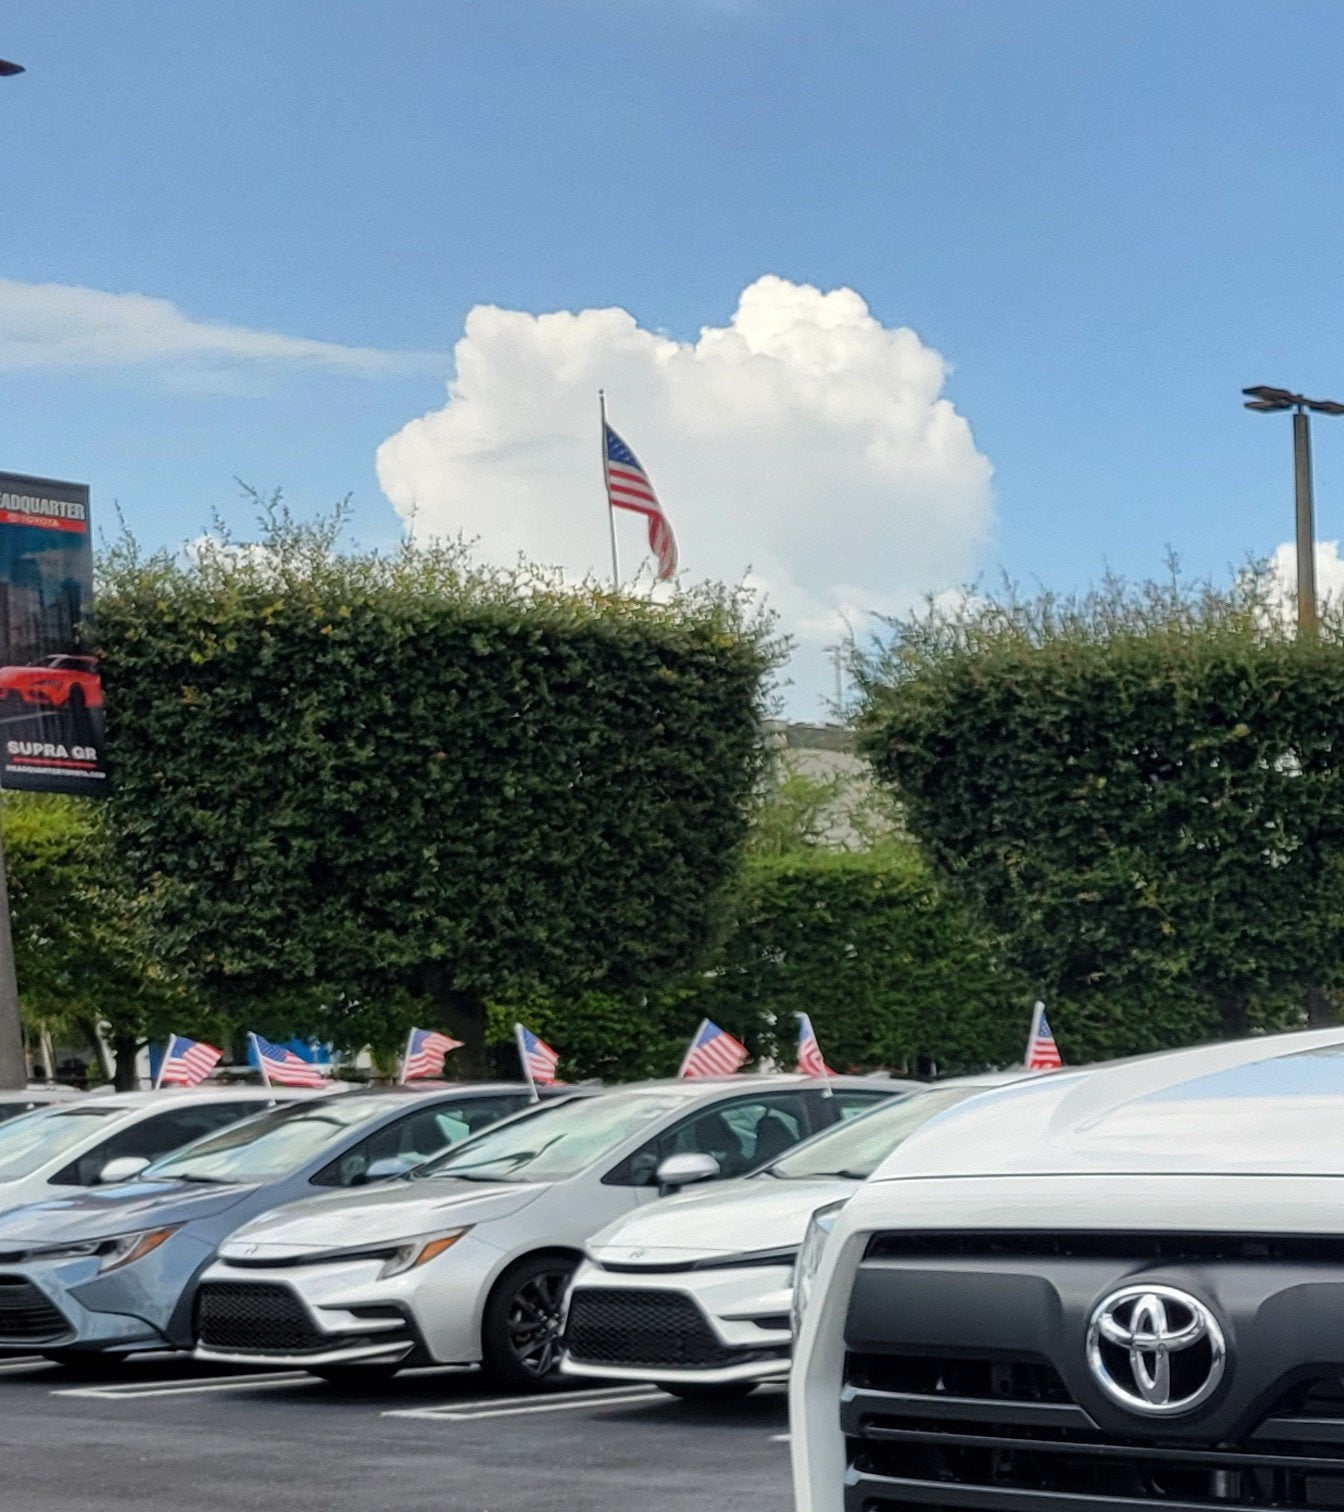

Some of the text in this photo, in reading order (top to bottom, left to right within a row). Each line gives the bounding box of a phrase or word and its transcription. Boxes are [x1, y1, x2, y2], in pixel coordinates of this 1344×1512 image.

[0, 492, 85, 520] ADQUARTER
[7, 741, 98, 760] SUPRA GR
